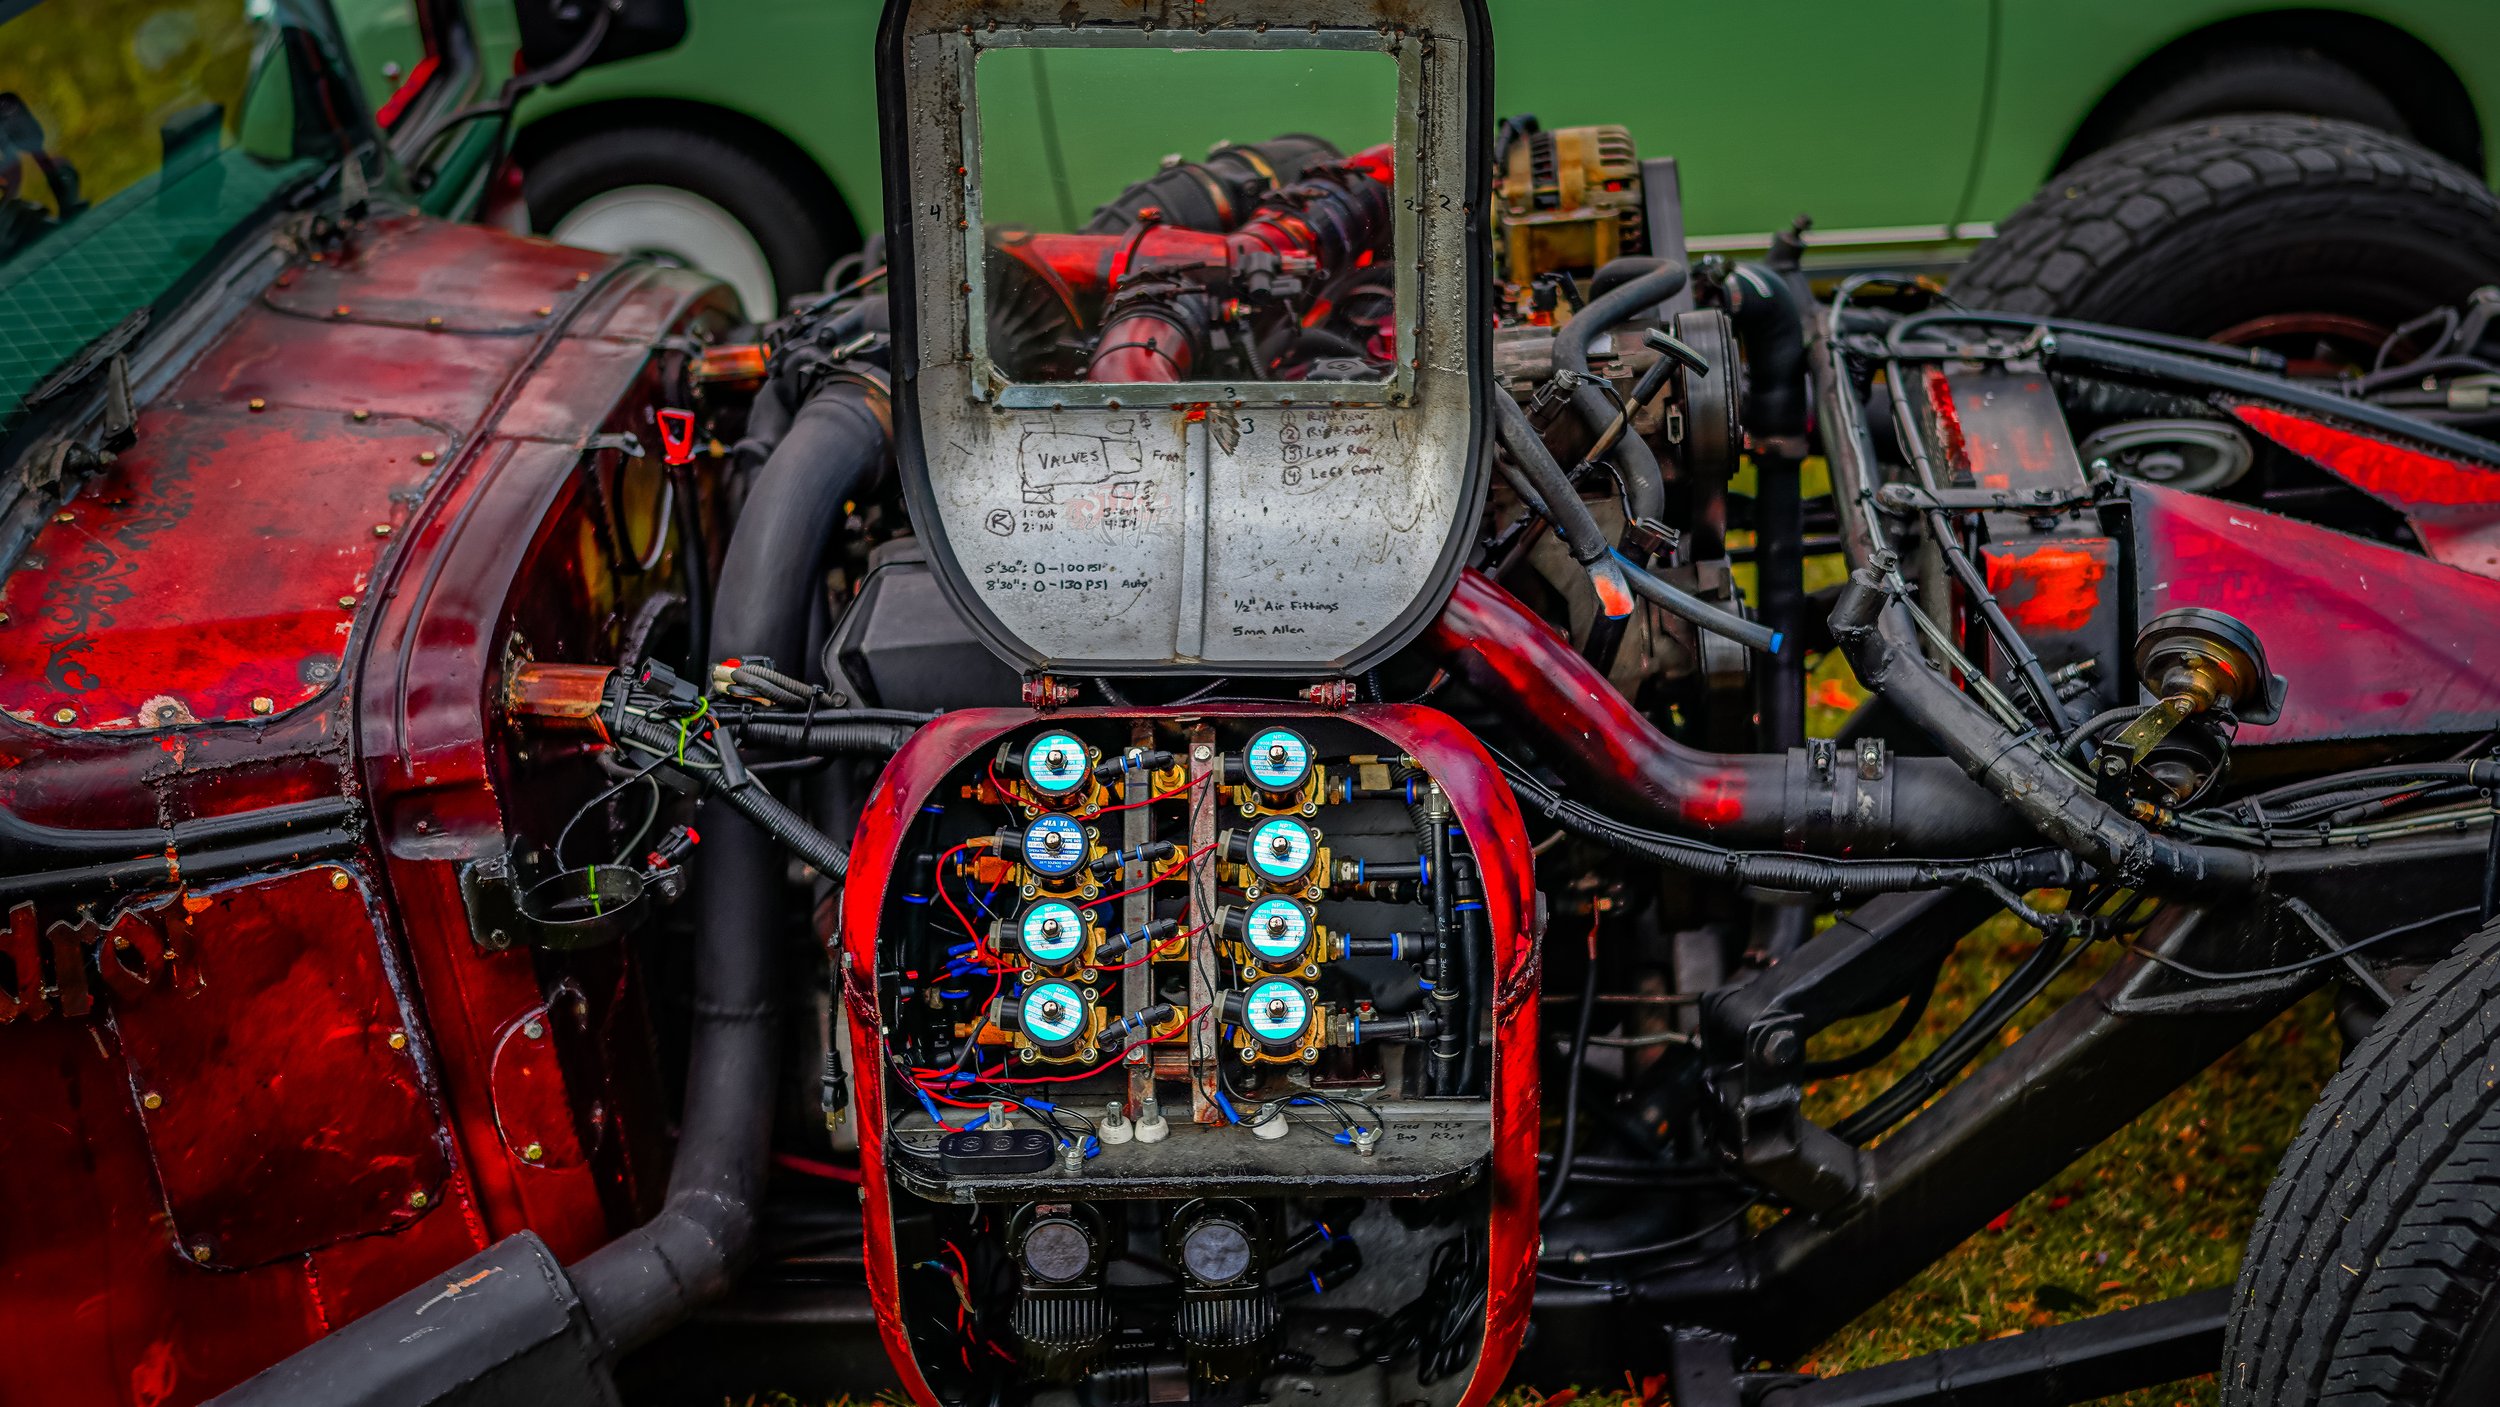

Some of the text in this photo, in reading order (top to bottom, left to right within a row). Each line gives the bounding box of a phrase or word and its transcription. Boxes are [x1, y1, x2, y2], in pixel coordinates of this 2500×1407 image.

[1404, 199, 1414, 210] 2
[1438, 194, 1452, 213] 2
[930, 204, 941, 222] 4
[1224, 386, 1236, 398] 3
[1241, 418, 1254, 434] 3
[1038, 451, 1100, 470] VALVES
[1086, 580, 1108, 591] PSI
[1121, 579, 1148, 589] Auto
[1264, 601, 1284, 612] Air
[1290, 602, 1339, 614] Fittings
[1232, 624, 1304, 636] 5mm Allen
